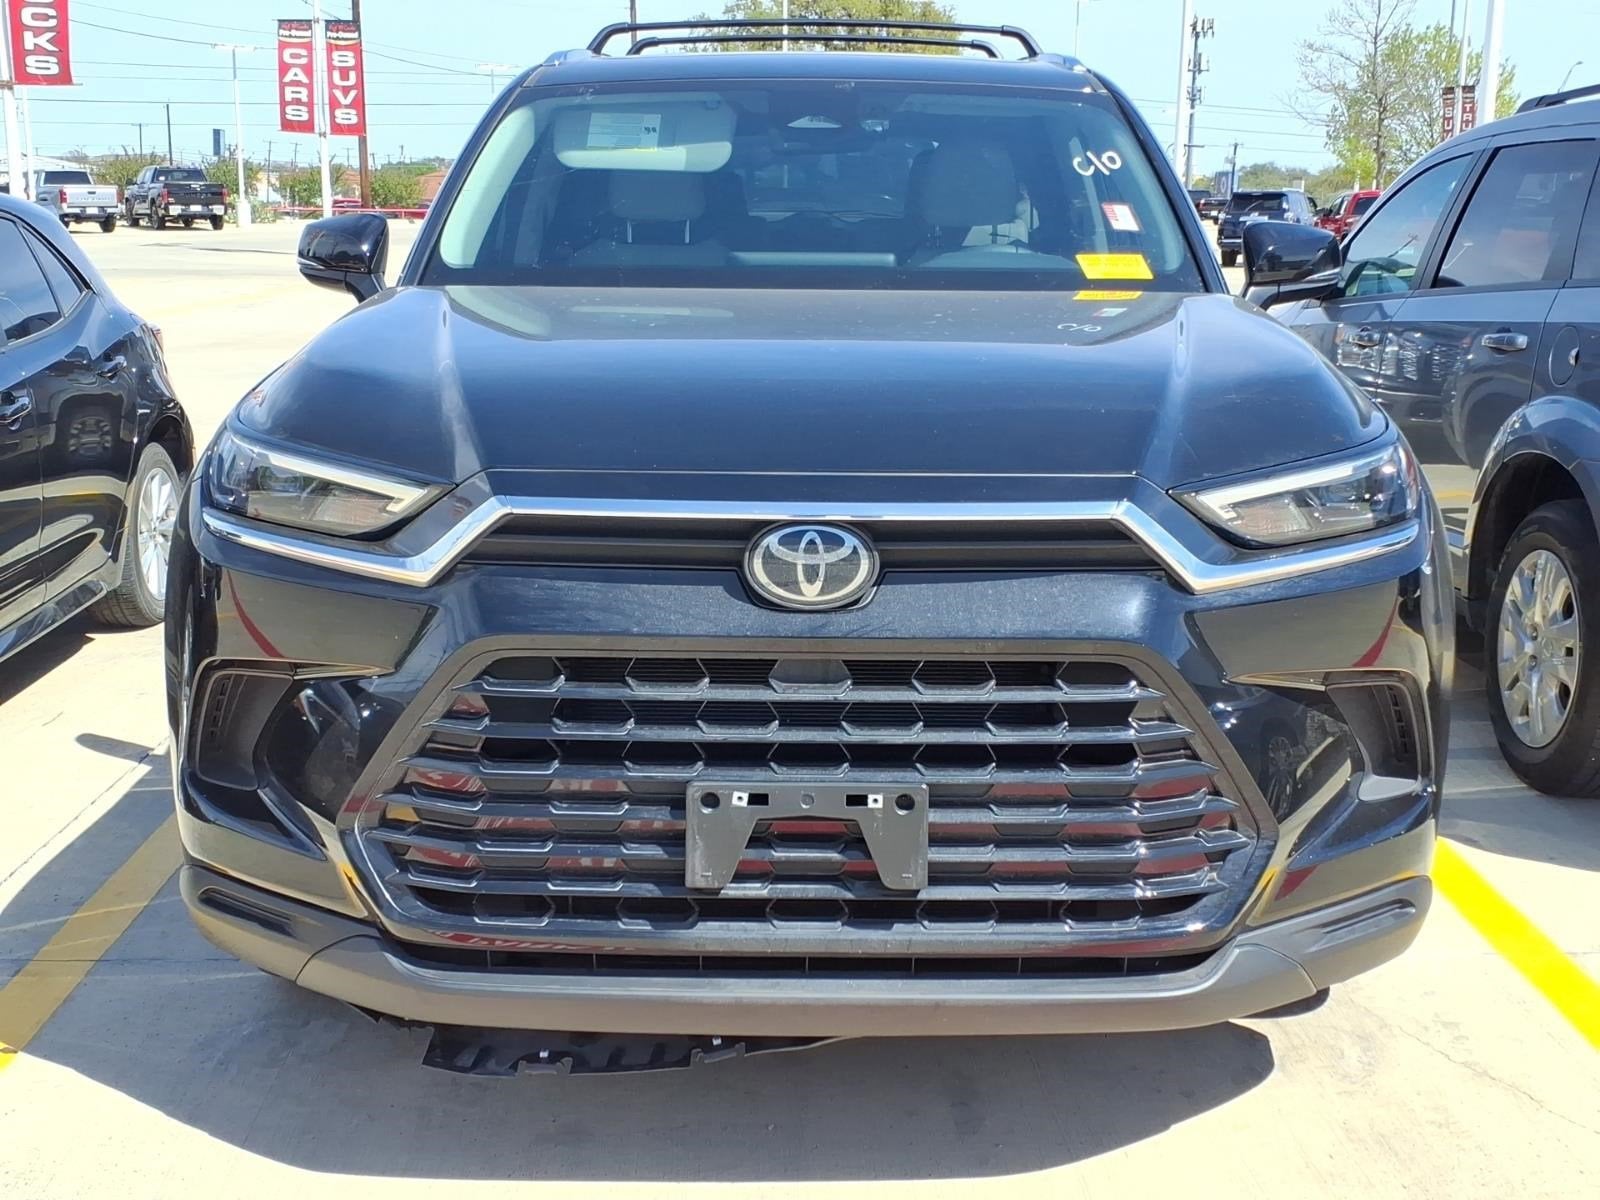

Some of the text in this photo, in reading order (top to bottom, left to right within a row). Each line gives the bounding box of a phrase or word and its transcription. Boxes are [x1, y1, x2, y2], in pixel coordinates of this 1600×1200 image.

[20, 0, 60, 75] CKS
[282, 47, 309, 121] CARS
[331, 50, 359, 125] SUVS
